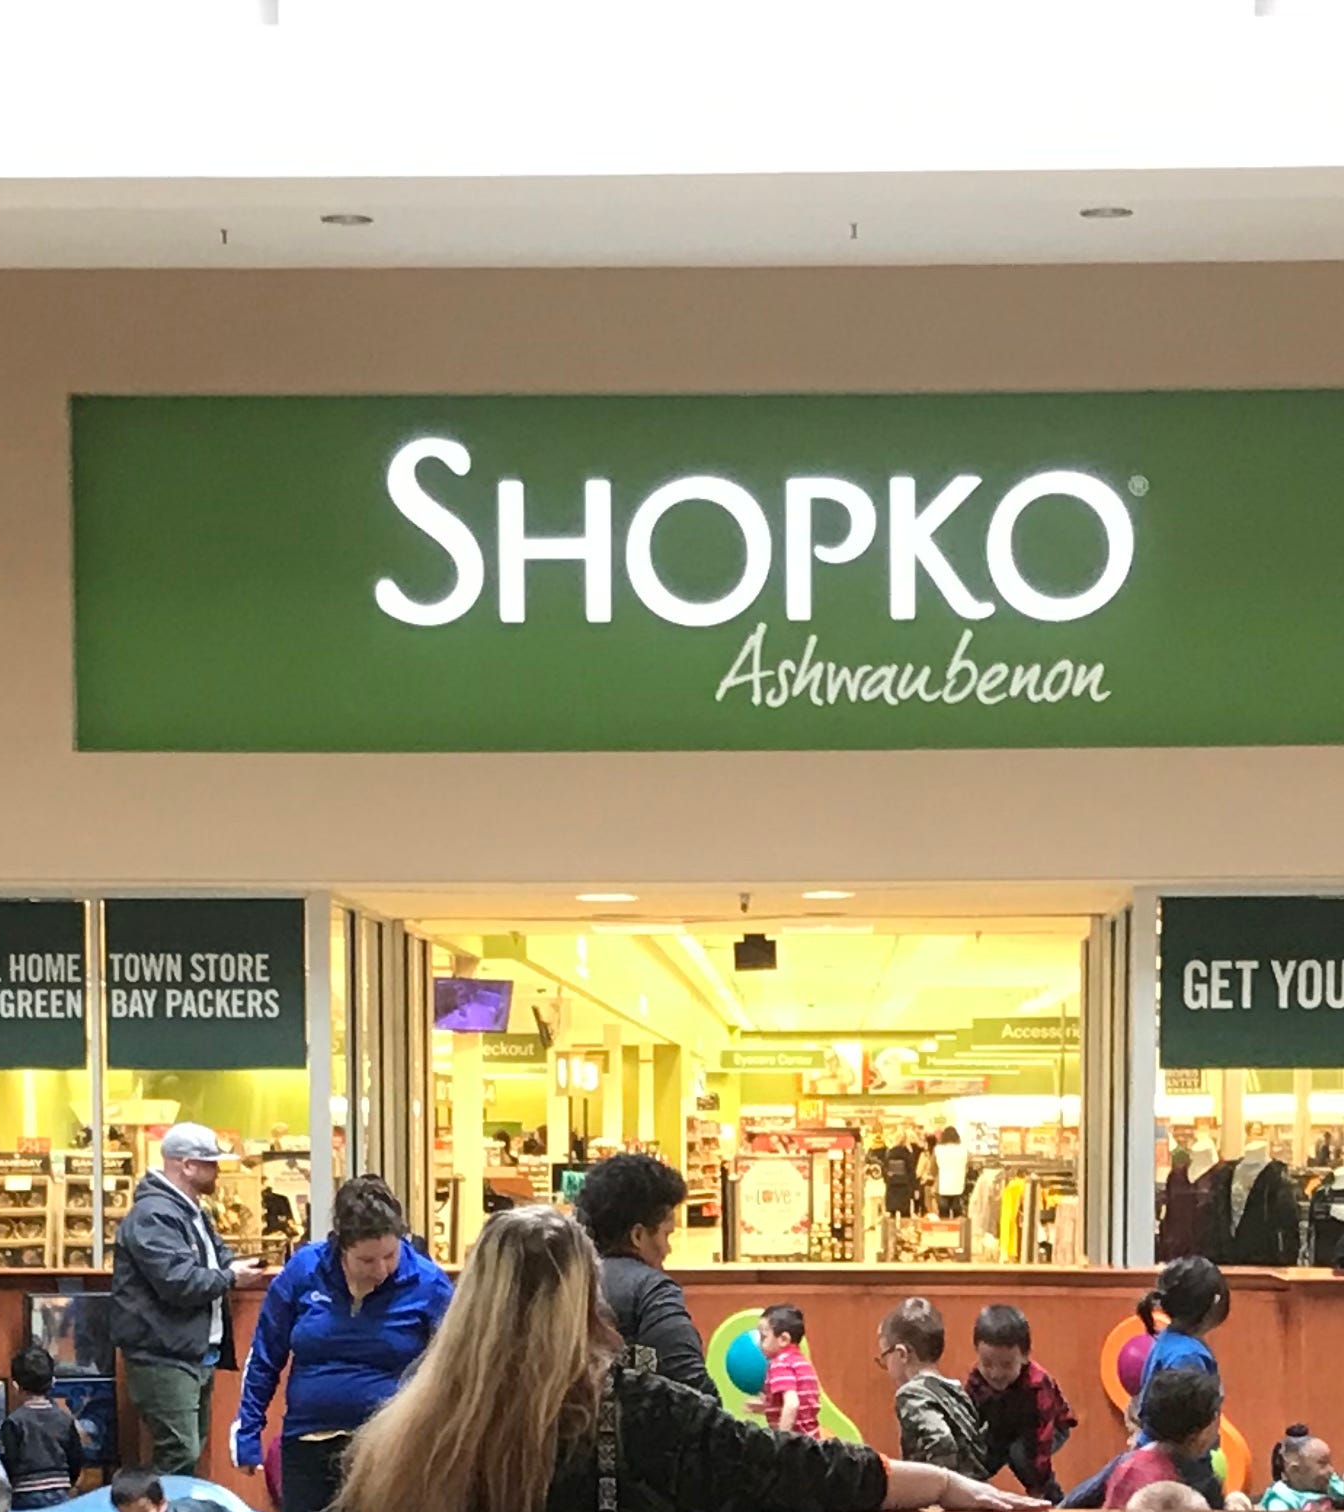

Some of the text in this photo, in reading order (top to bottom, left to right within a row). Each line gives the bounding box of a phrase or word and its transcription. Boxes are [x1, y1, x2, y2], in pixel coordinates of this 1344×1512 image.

[716, 622, 1110, 708] Ashwaubenon
[9, 953, 82, 983] HOME
[109, 952, 182, 983] TOWN
[190, 952, 270, 983] STORE
[1183, 960, 1259, 1010] GET
[0, 988, 82, 1019] GREEN
[111, 988, 157, 1018] BAY
[165, 988, 280, 1018] PACKERS
[483, 1042, 534, 1056] eckout
